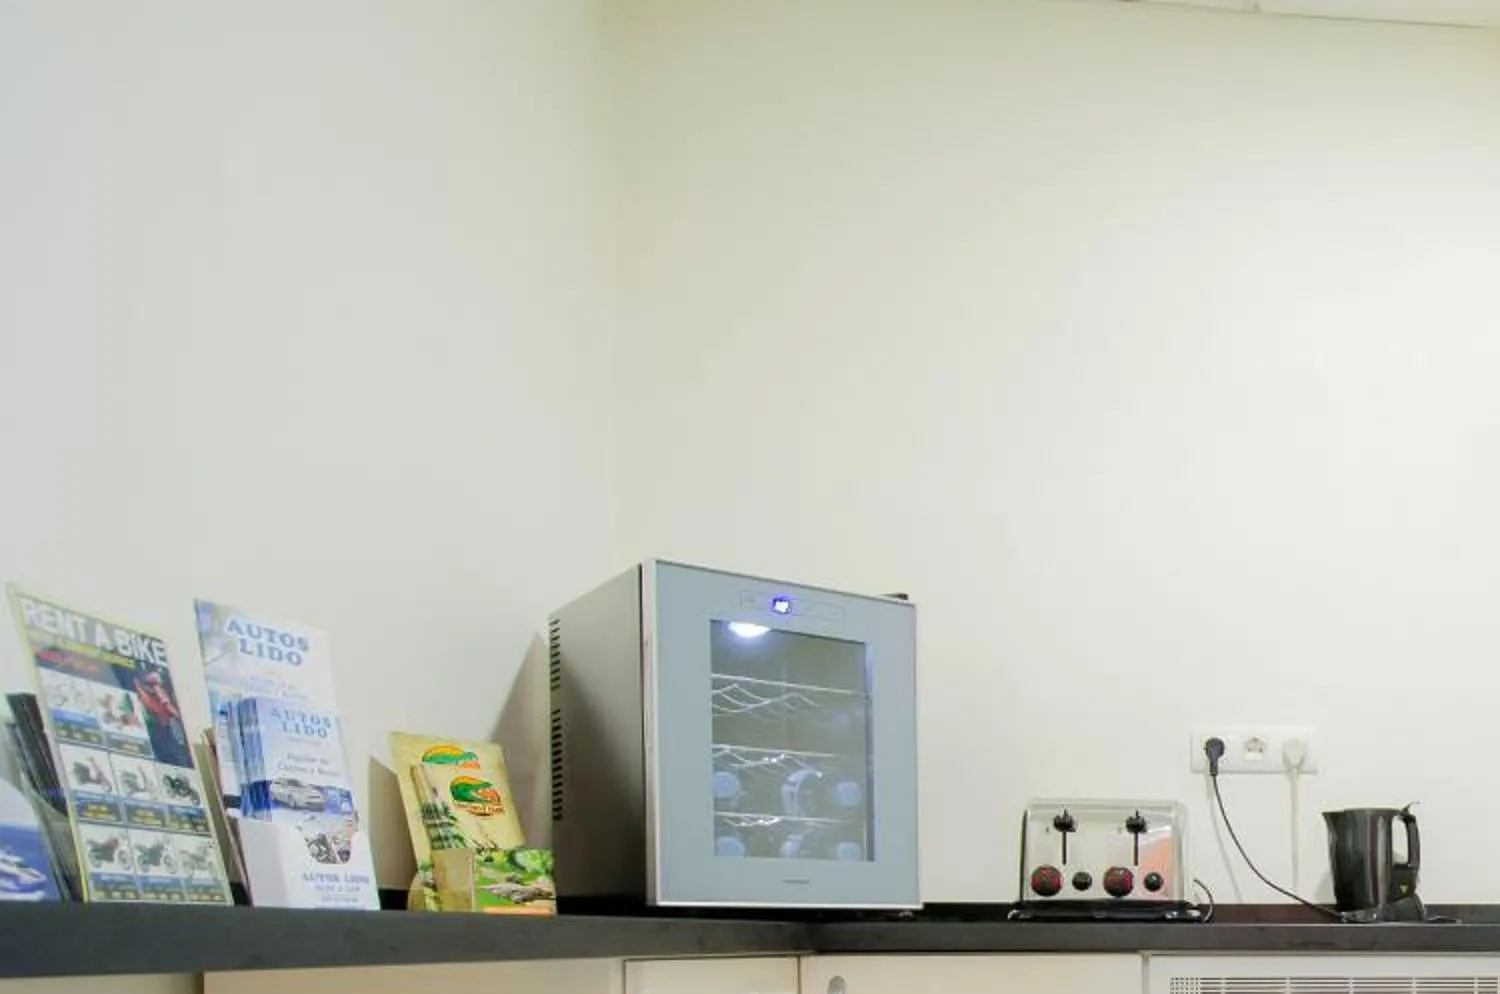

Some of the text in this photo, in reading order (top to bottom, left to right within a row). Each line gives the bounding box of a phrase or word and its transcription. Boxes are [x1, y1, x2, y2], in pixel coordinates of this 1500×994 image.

[22, 599, 88, 643] RENT
[94, 622, 114, 651] A
[114, 628, 169, 668] BIKE
[226, 619, 310, 651] AUTOS
[238, 637, 303, 667] LIDO
[270, 706, 332, 730] AUTOS
[281, 721, 328, 739] LIDO
